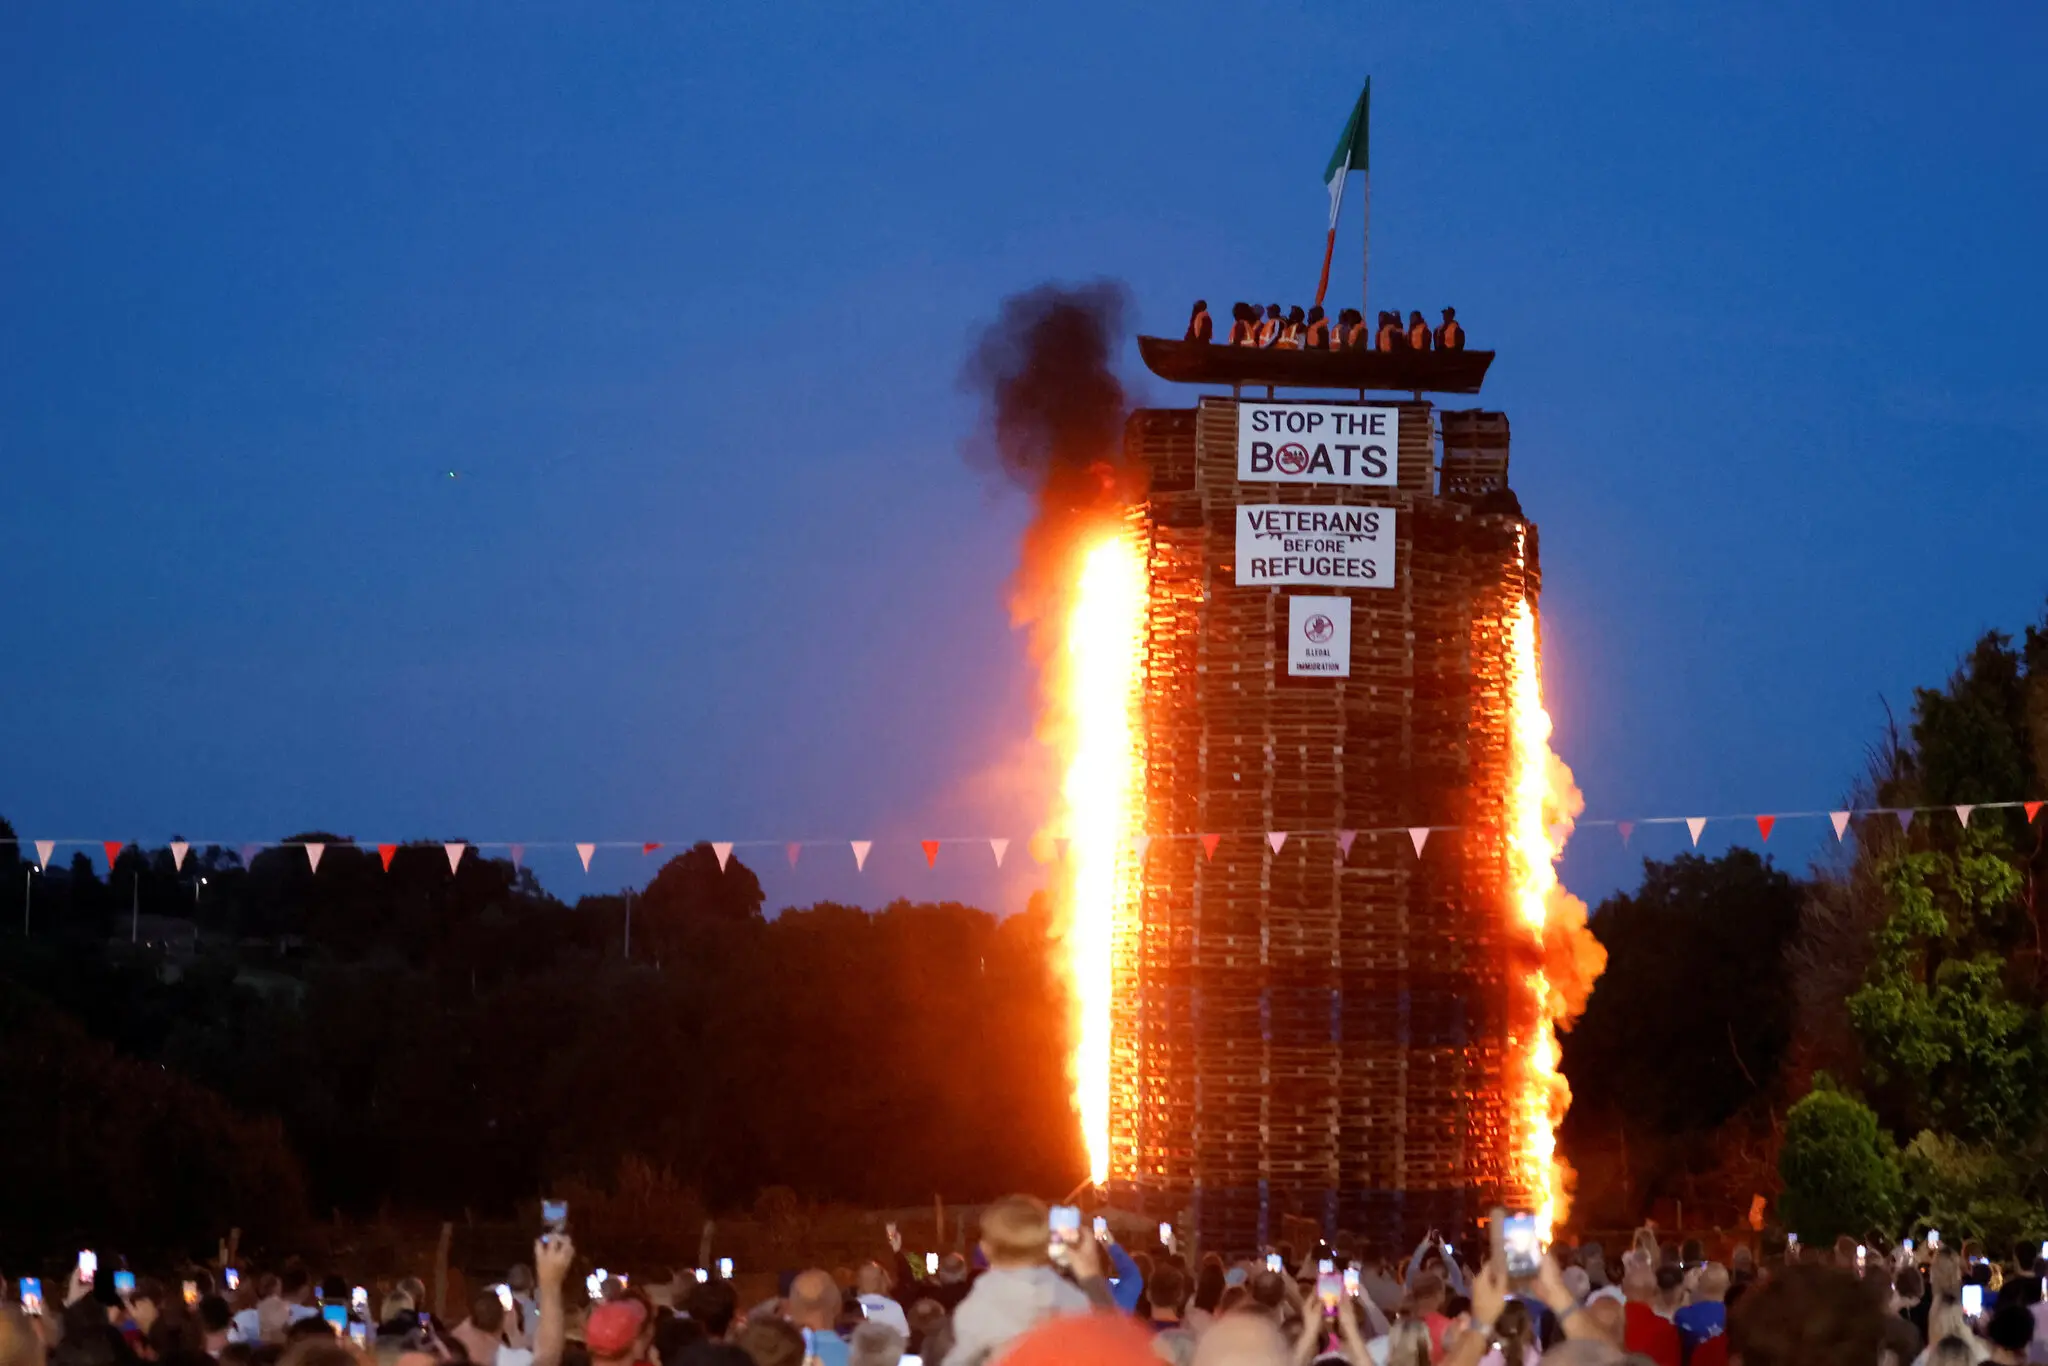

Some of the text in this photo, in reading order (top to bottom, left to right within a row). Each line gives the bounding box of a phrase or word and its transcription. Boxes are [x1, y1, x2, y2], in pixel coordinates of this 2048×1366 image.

[1251, 409, 1386, 436] STOP THE
[1251, 441, 1388, 479] BOATS
[1247, 510, 1380, 533] VETERANS
[1283, 538, 1346, 553] BEFORE
[1251, 557, 1377, 579] REFUGEES
